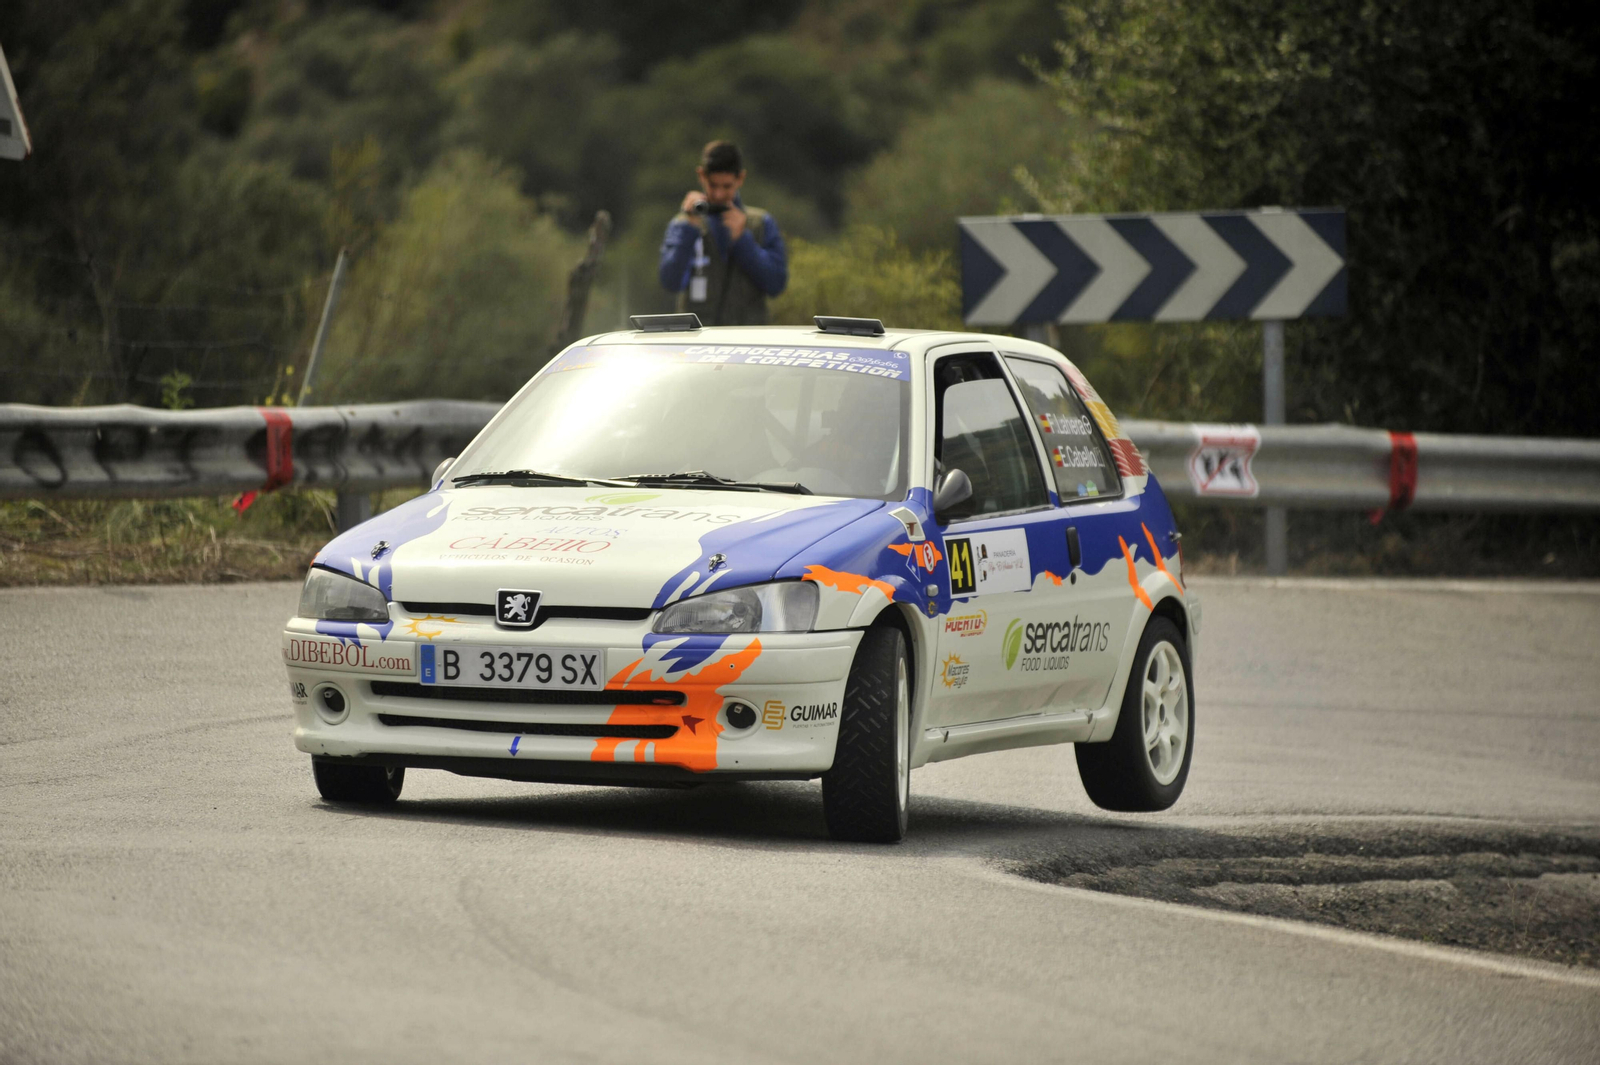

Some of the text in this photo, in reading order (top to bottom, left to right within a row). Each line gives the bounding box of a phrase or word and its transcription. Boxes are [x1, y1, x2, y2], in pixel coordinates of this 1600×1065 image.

[684, 346, 850, 361] CARROCERIAS
[697, 355, 903, 379] DE COMPETICION
[461, 505, 741, 524] sercatrans
[536, 525, 629, 537] AUTOS
[540, 555, 594, 566] OCASION
[951, 542, 973, 588] 41
[1024, 614, 1110, 654] sercatrans
[425, 667, 432, 677] E
[443, 650, 597, 685] B 3379 SX
[1021, 656, 1070, 672] FOOD LIQUIDS
[790, 702, 837, 721] GUIMAR
